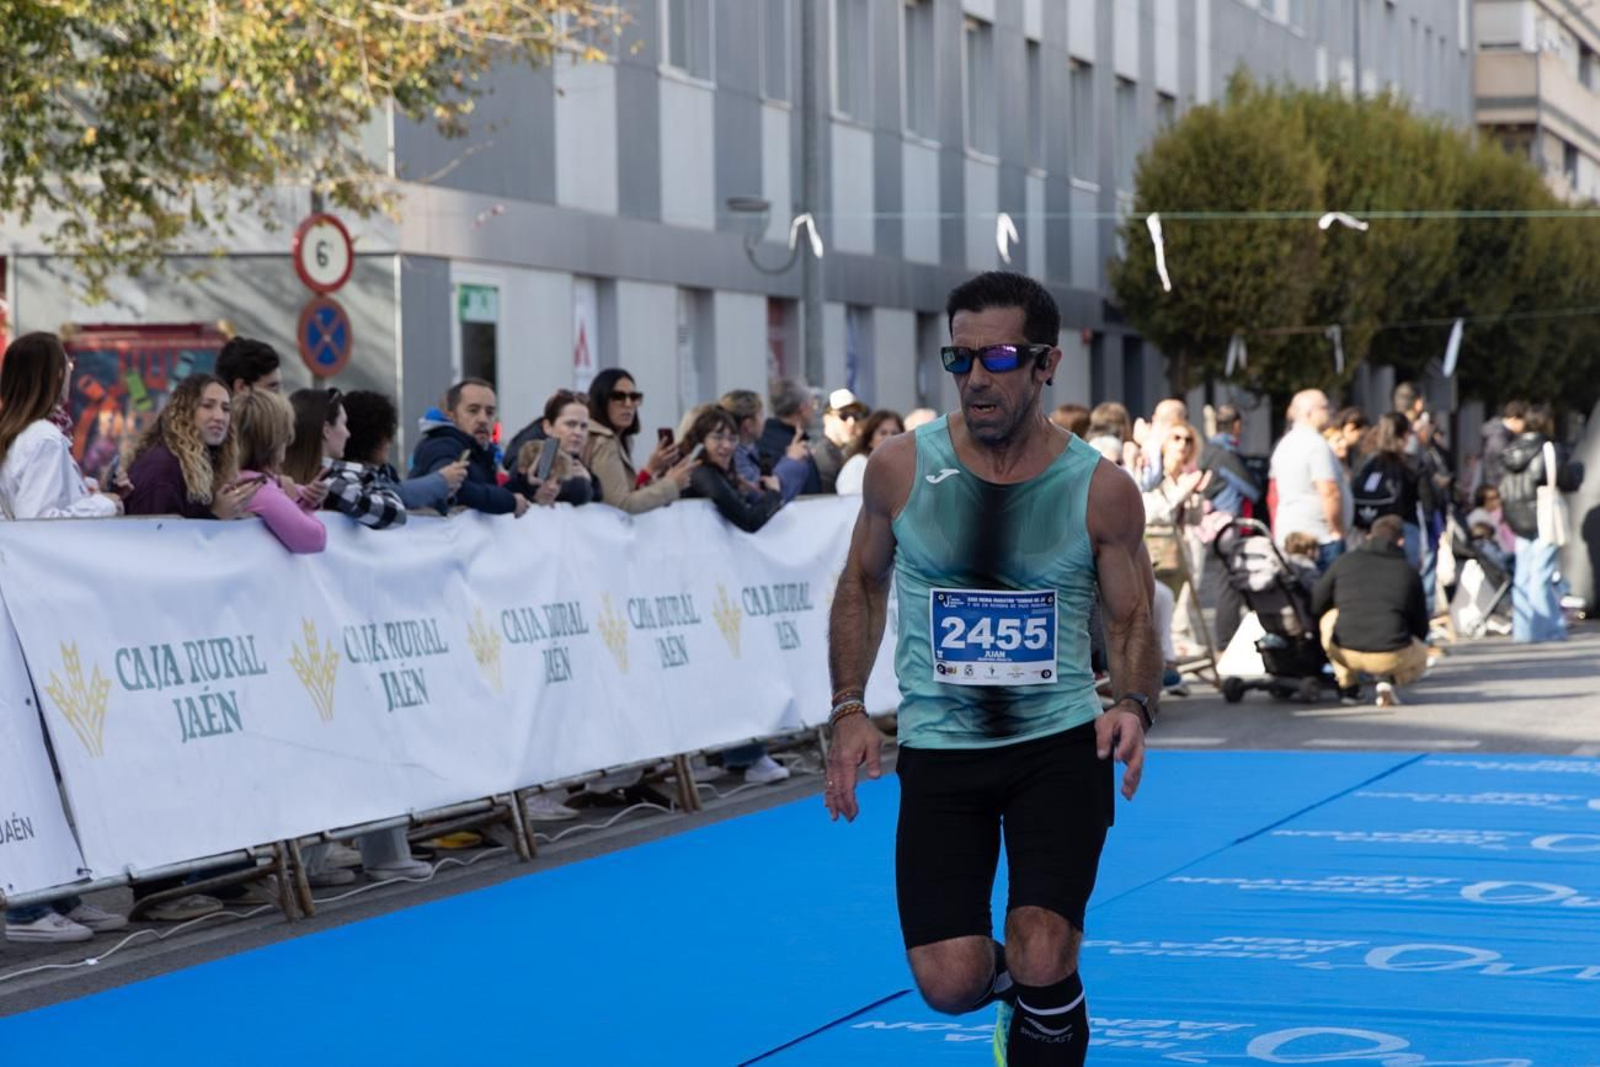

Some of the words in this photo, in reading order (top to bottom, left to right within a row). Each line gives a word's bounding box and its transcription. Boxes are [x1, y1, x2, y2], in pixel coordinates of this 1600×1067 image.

[343, 623, 390, 666] CAJA
[384, 618, 449, 660] RURAL
[501, 606, 548, 645] CAJA
[941, 617, 1048, 650] 2455
[115, 643, 185, 691] CAJA
[183, 634, 268, 683] RURAL
[379, 662, 430, 713] JAÉN
[172, 685, 243, 743] JAÉN
